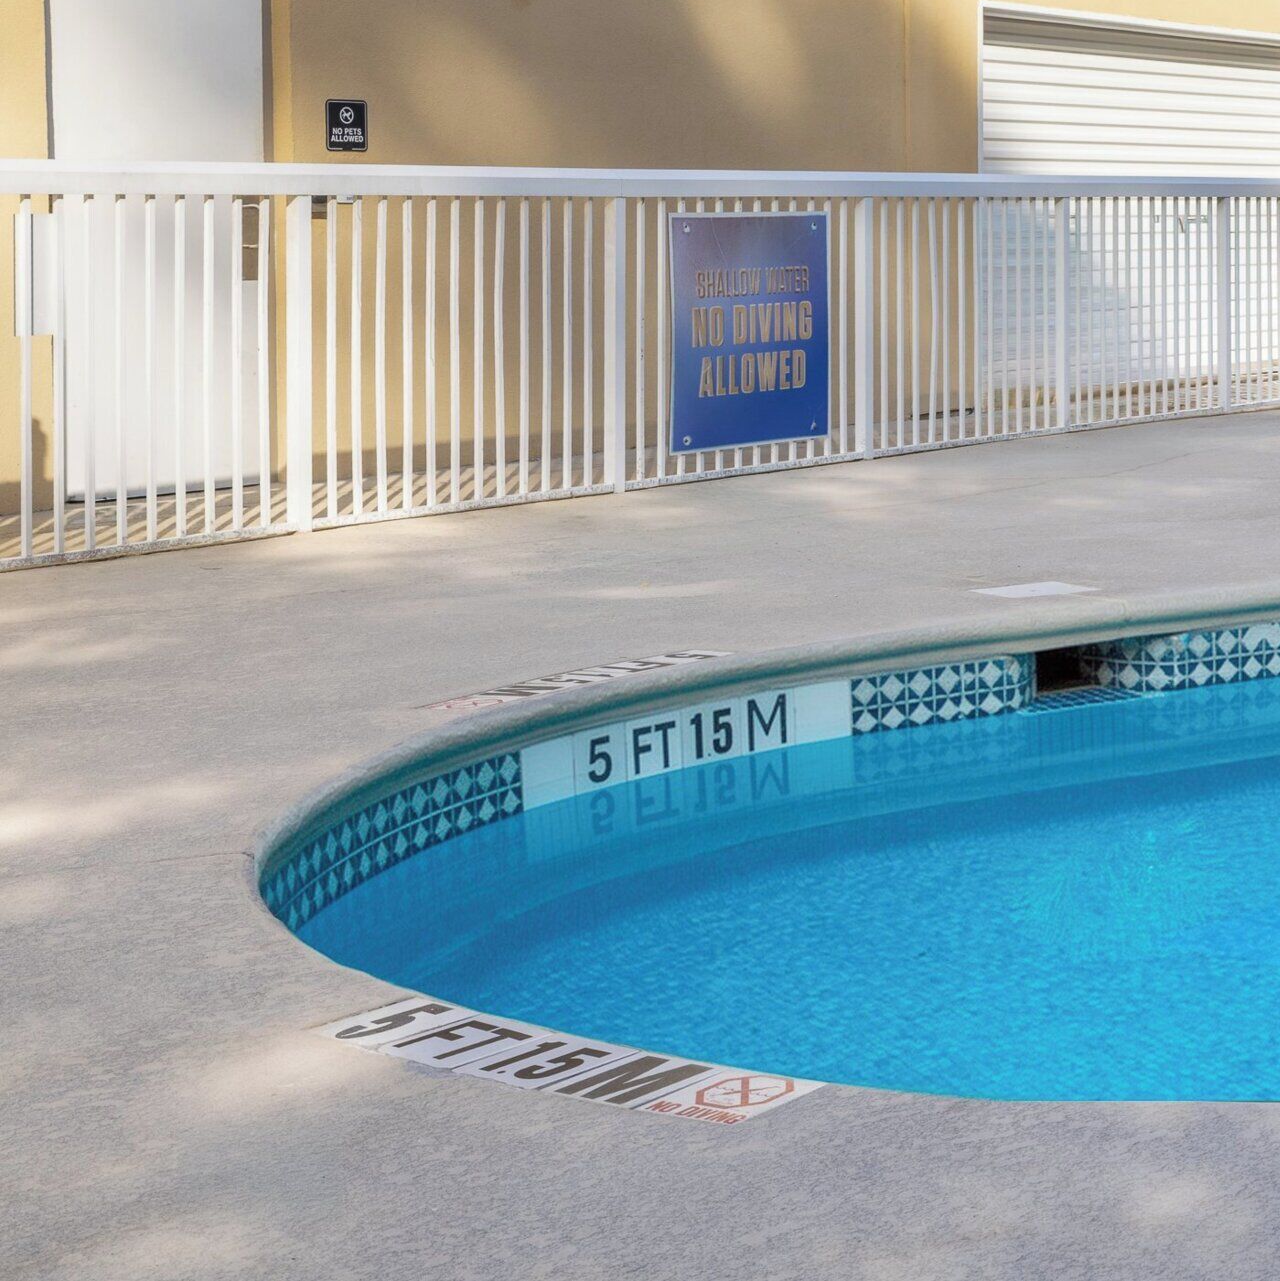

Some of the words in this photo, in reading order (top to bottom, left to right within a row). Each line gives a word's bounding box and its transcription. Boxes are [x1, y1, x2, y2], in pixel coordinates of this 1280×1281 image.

[331, 135, 364, 143] ALLOWED
[332, 127, 343, 135] NO
[344, 127, 362, 135] PETS
[697, 267, 761, 299] SHALLOW
[765, 265, 809, 295] WATER
[691, 305, 724, 348] NO
[733, 300, 812, 345] DIVING
[698, 349, 806, 398] ALLOWED
[587, 735, 612, 783] 5
[632, 720, 676, 775] FT
[747, 693, 787, 752] M
[335, 1003, 454, 1040] 5
[392, 1020, 533, 1060] FT
[554, 1055, 713, 1104] M
[647, 1100, 682, 1113] NO
[676, 1106, 746, 1125] DIVING
